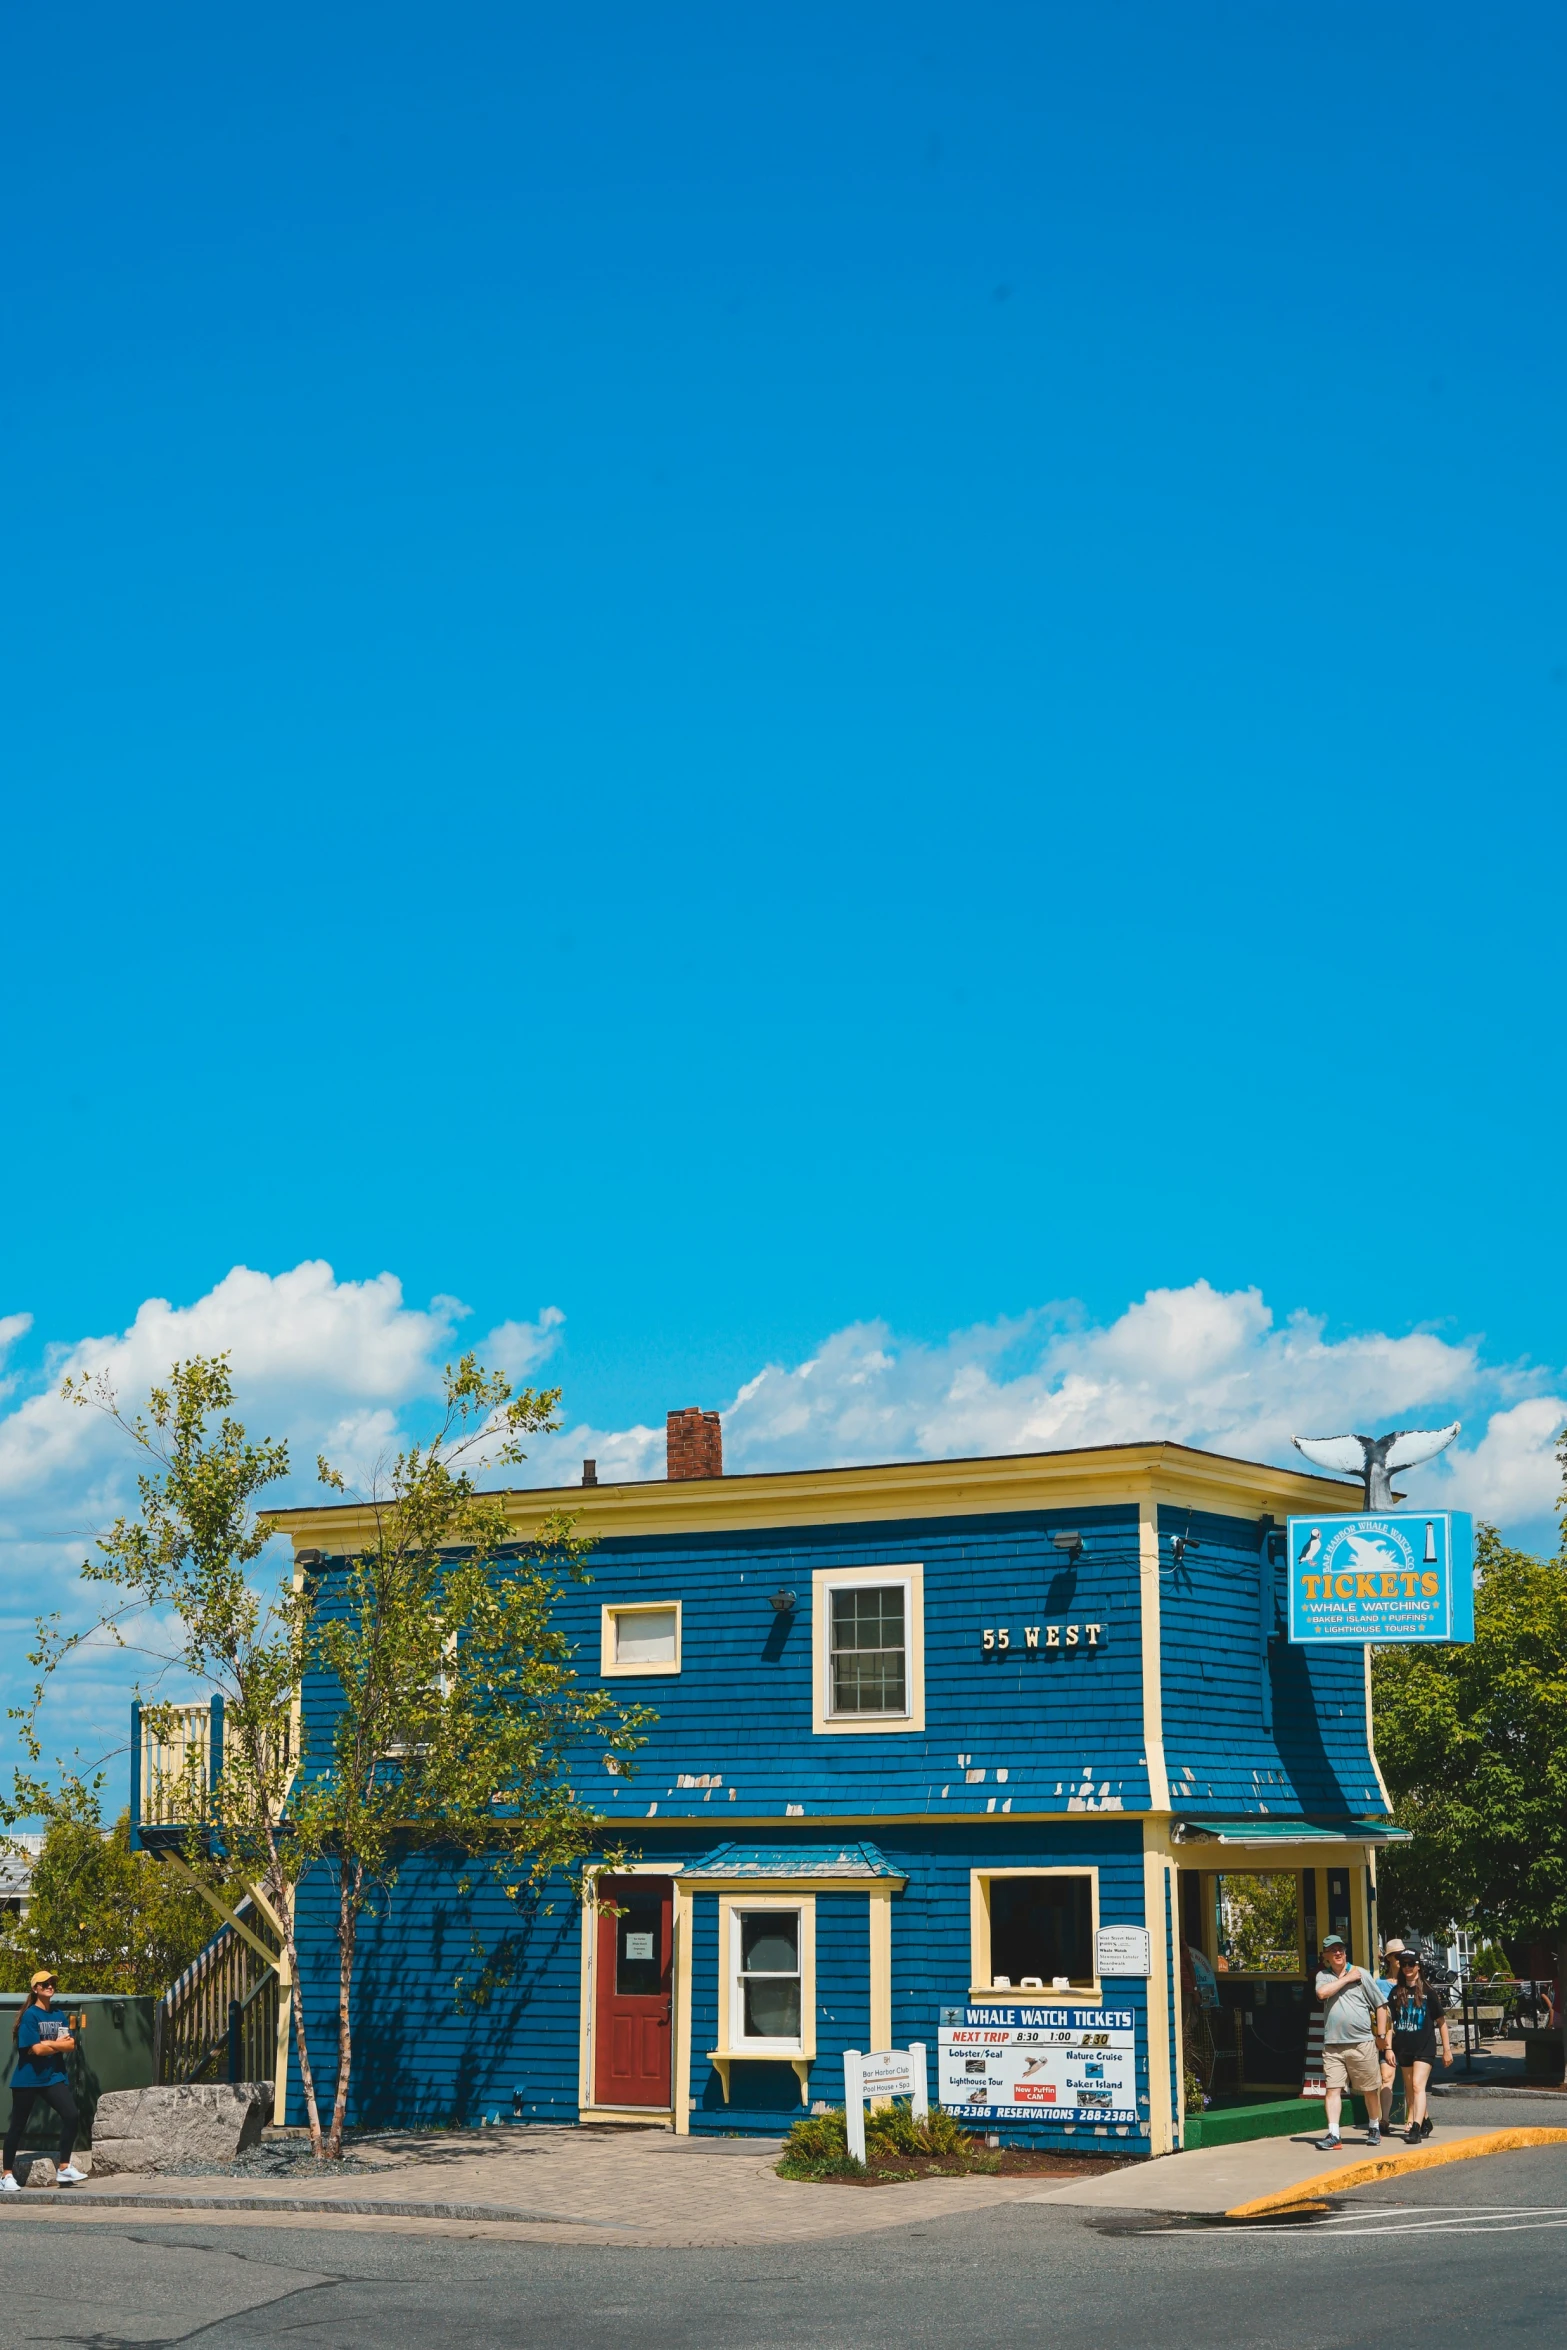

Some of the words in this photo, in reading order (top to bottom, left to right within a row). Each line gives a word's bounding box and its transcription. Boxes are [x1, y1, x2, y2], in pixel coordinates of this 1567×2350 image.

[1322, 1554, 1330, 1573] BAR
[1326, 1525, 1356, 1553] HARBOR
[1358, 1521, 1388, 1532] WHALE
[1390, 1528, 1414, 1556] WATCH
[1407, 1556, 1415, 1570] CO
[1301, 1572, 1440, 1600] TICKETS
[1310, 1602, 1357, 1613] WHALE
[1362, 1600, 1430, 1612] WATCHING
[983, 1628, 1009, 1650] 55
[1024, 1624, 1101, 1648] WEST
[966, 2009, 1015, 2025] WHALE
[1021, 2009, 1067, 2026] WATCH
[1073, 2011, 1132, 2027] TICKETS
[952, 2032, 981, 2042] NEXT
[983, 2032, 1010, 2042] TRIP
[1016, 2032, 1039, 2041] 8:30
[1050, 2032, 1071, 2041] 1:00
[1082, 2034, 1109, 2045] 2:30
[949, 2049, 1002, 2059] Lobster/Seal
[1066, 2051, 1095, 2060] Nature
[1096, 2052, 1123, 2061] Cruise
[950, 2076, 986, 2086] Lighthouse
[988, 2077, 1004, 2086] Tour
[1066, 2079, 1093, 2088] Baker
[1095, 2080, 1123, 2089] Island
[996, 2107, 1074, 2120] RESERVATIONS
[1079, 2110, 1134, 2122] 288-2386
